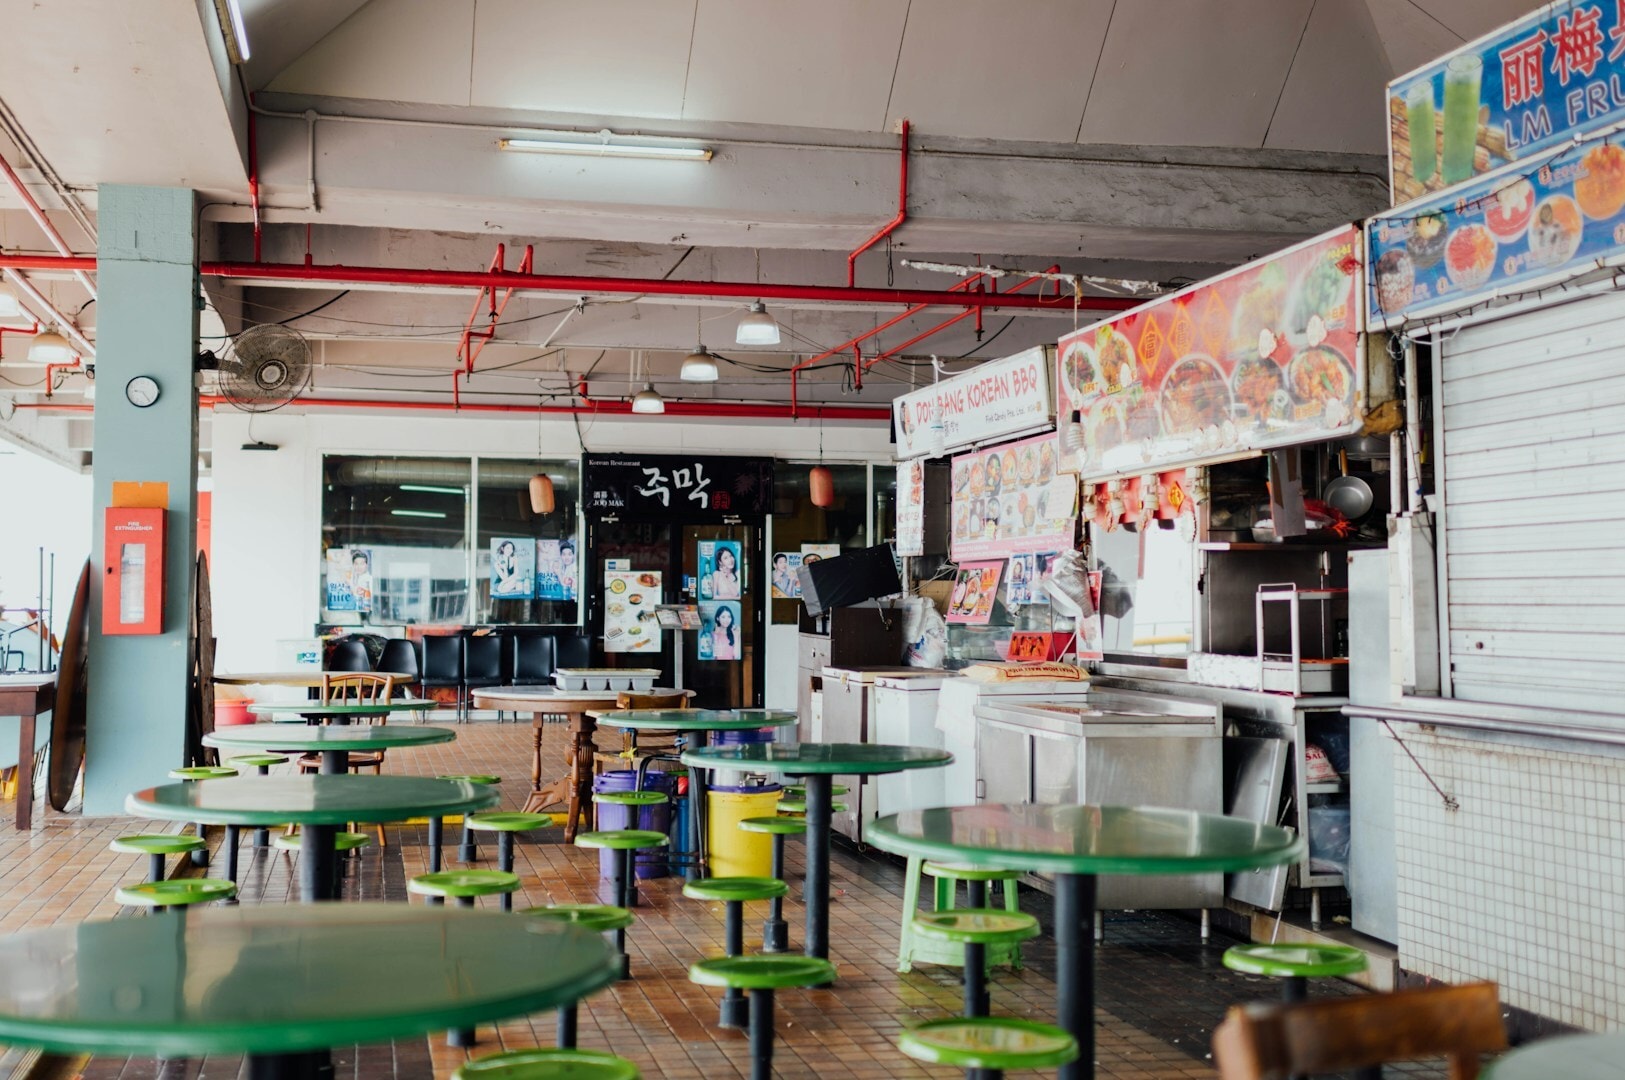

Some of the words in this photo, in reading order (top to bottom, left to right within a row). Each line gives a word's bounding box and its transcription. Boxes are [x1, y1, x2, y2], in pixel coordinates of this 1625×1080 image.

[1504, 105, 1553, 151] LM
[937, 388, 964, 417] BANG
[966, 374, 1010, 410] KOREAN
[1012, 363, 1038, 398] BBQ
[608, 499, 625, 507] MAK
[639, 463, 711, 509] 주막
